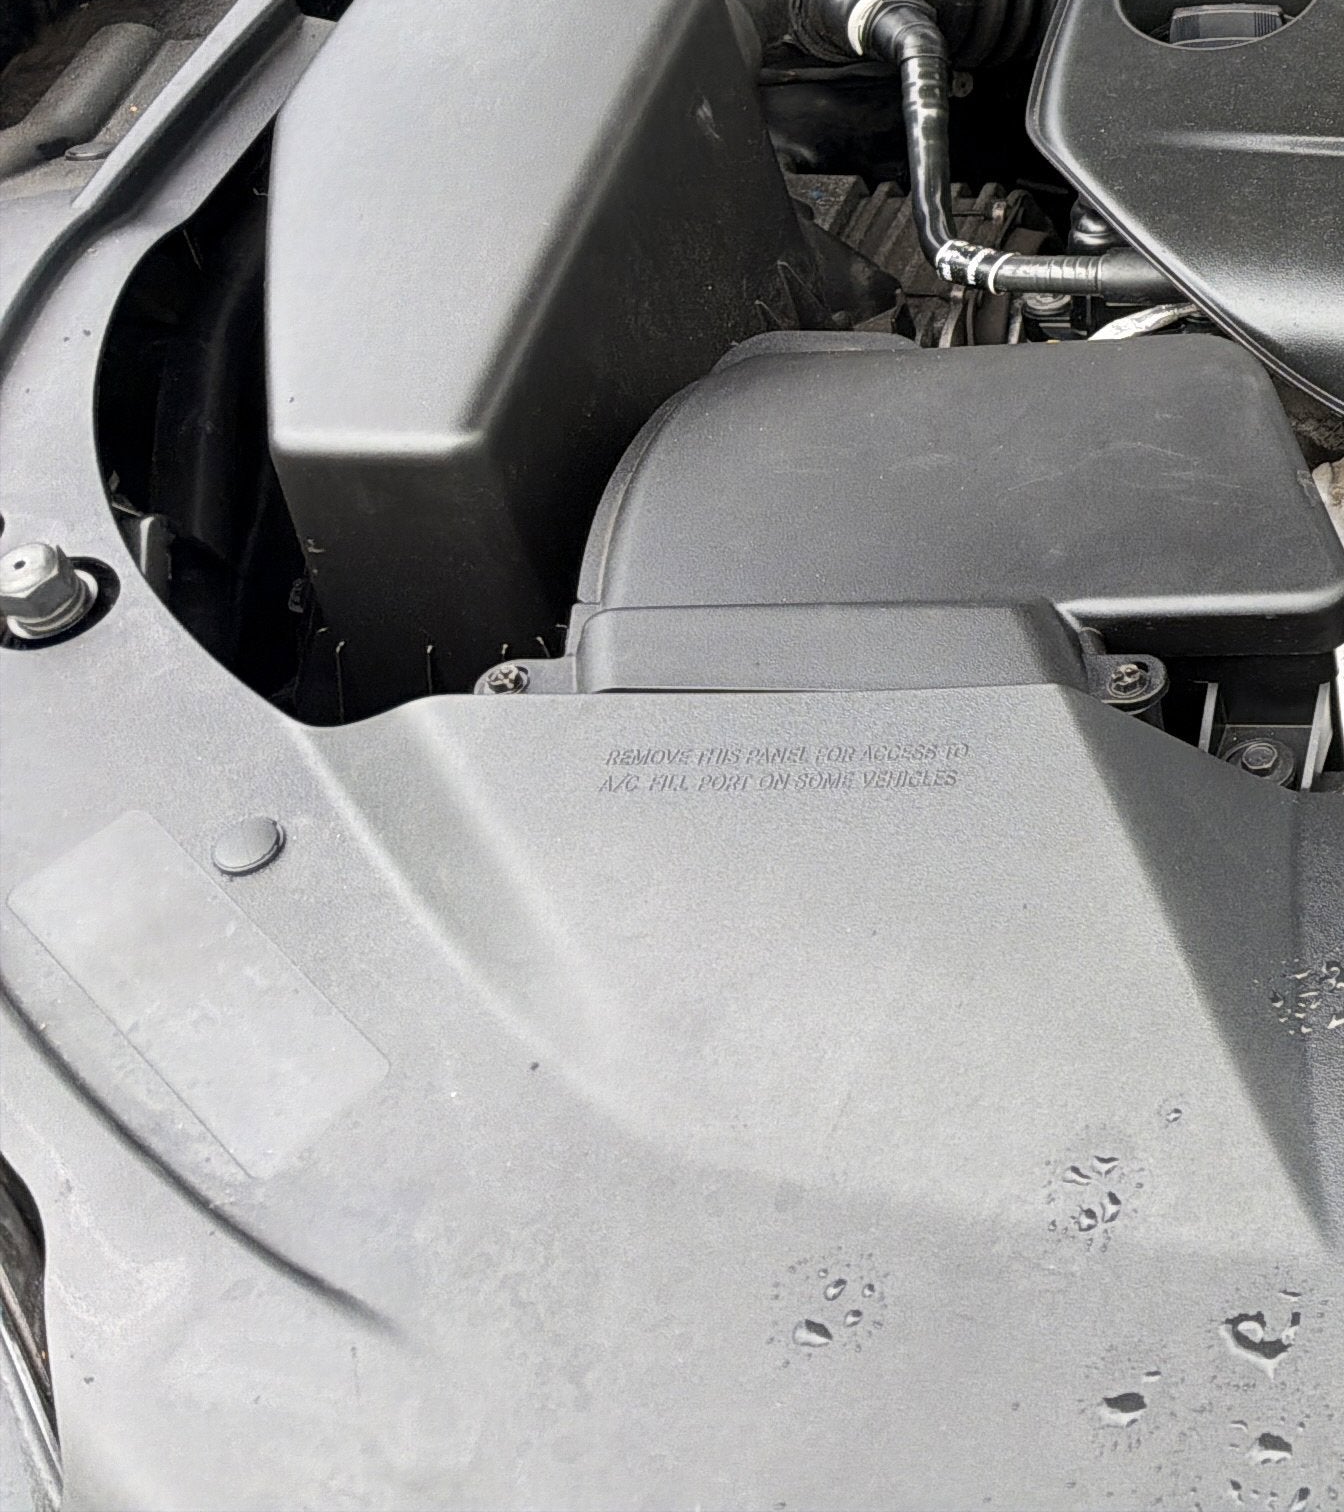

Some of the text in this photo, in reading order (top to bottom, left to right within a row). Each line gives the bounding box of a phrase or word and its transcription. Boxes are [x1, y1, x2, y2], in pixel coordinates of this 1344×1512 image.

[605, 742, 970, 766] REMOVE THIS PANEL FOR ACCESS TO
[600, 769, 958, 794] A/C FILL PORT ON SOME VEHICLES
